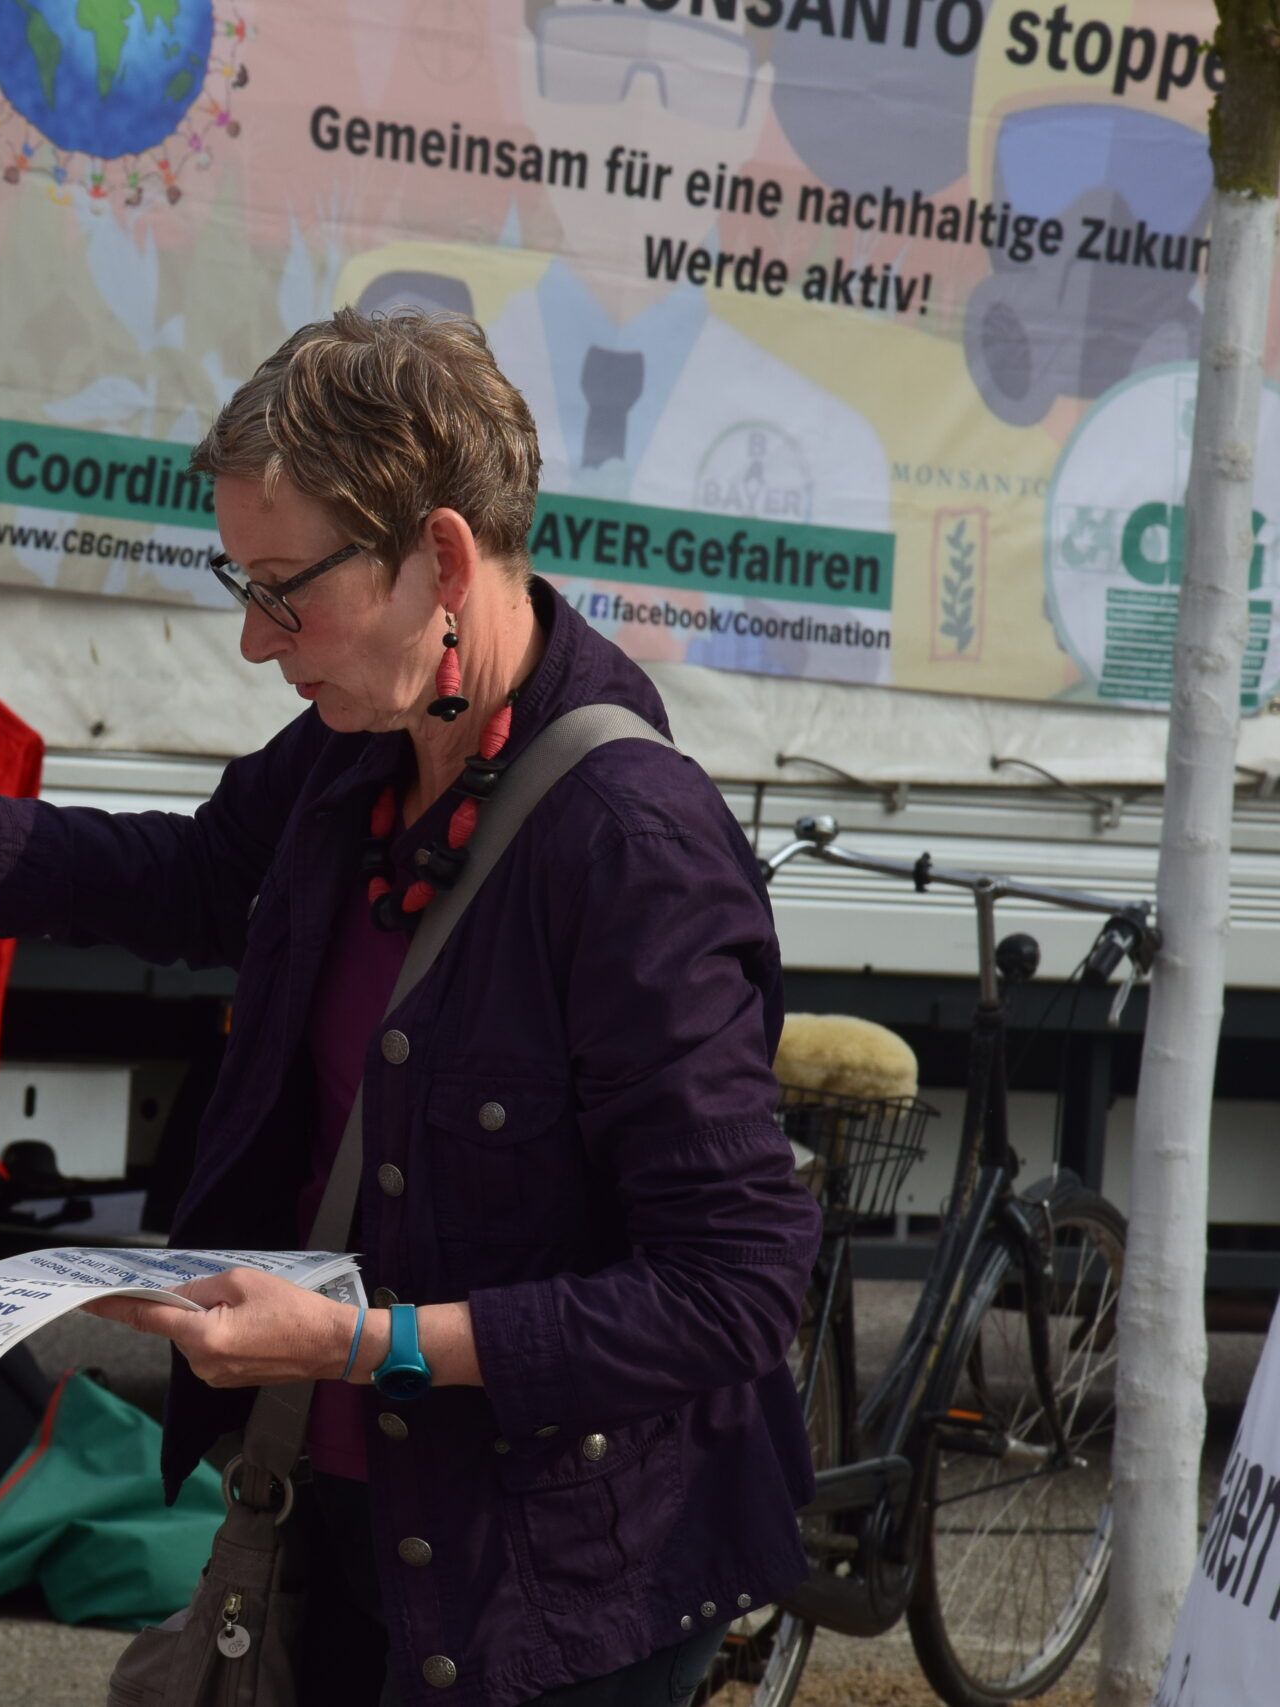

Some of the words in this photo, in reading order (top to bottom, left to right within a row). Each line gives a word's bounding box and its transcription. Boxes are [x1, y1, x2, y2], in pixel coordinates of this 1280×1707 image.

[309, 104, 589, 190] Gemeinsam
[606, 145, 672, 201] für
[685, 162, 784, 219] eine
[797, 184, 1064, 264] nachhaltige
[643, 234, 789, 298] Werde
[801, 257, 933, 316] aktiv!
[891, 460, 1050, 498] MONSANTO
[612, 596, 892, 650] facebook/Coordination
[81, 1258, 108, 1271] und
[107, 1264, 140, 1283] Moral
[146, 1259, 175, 1273] gegen
[175, 1268, 197, 1281] Sie
[4, 1287, 52, 1301] und
